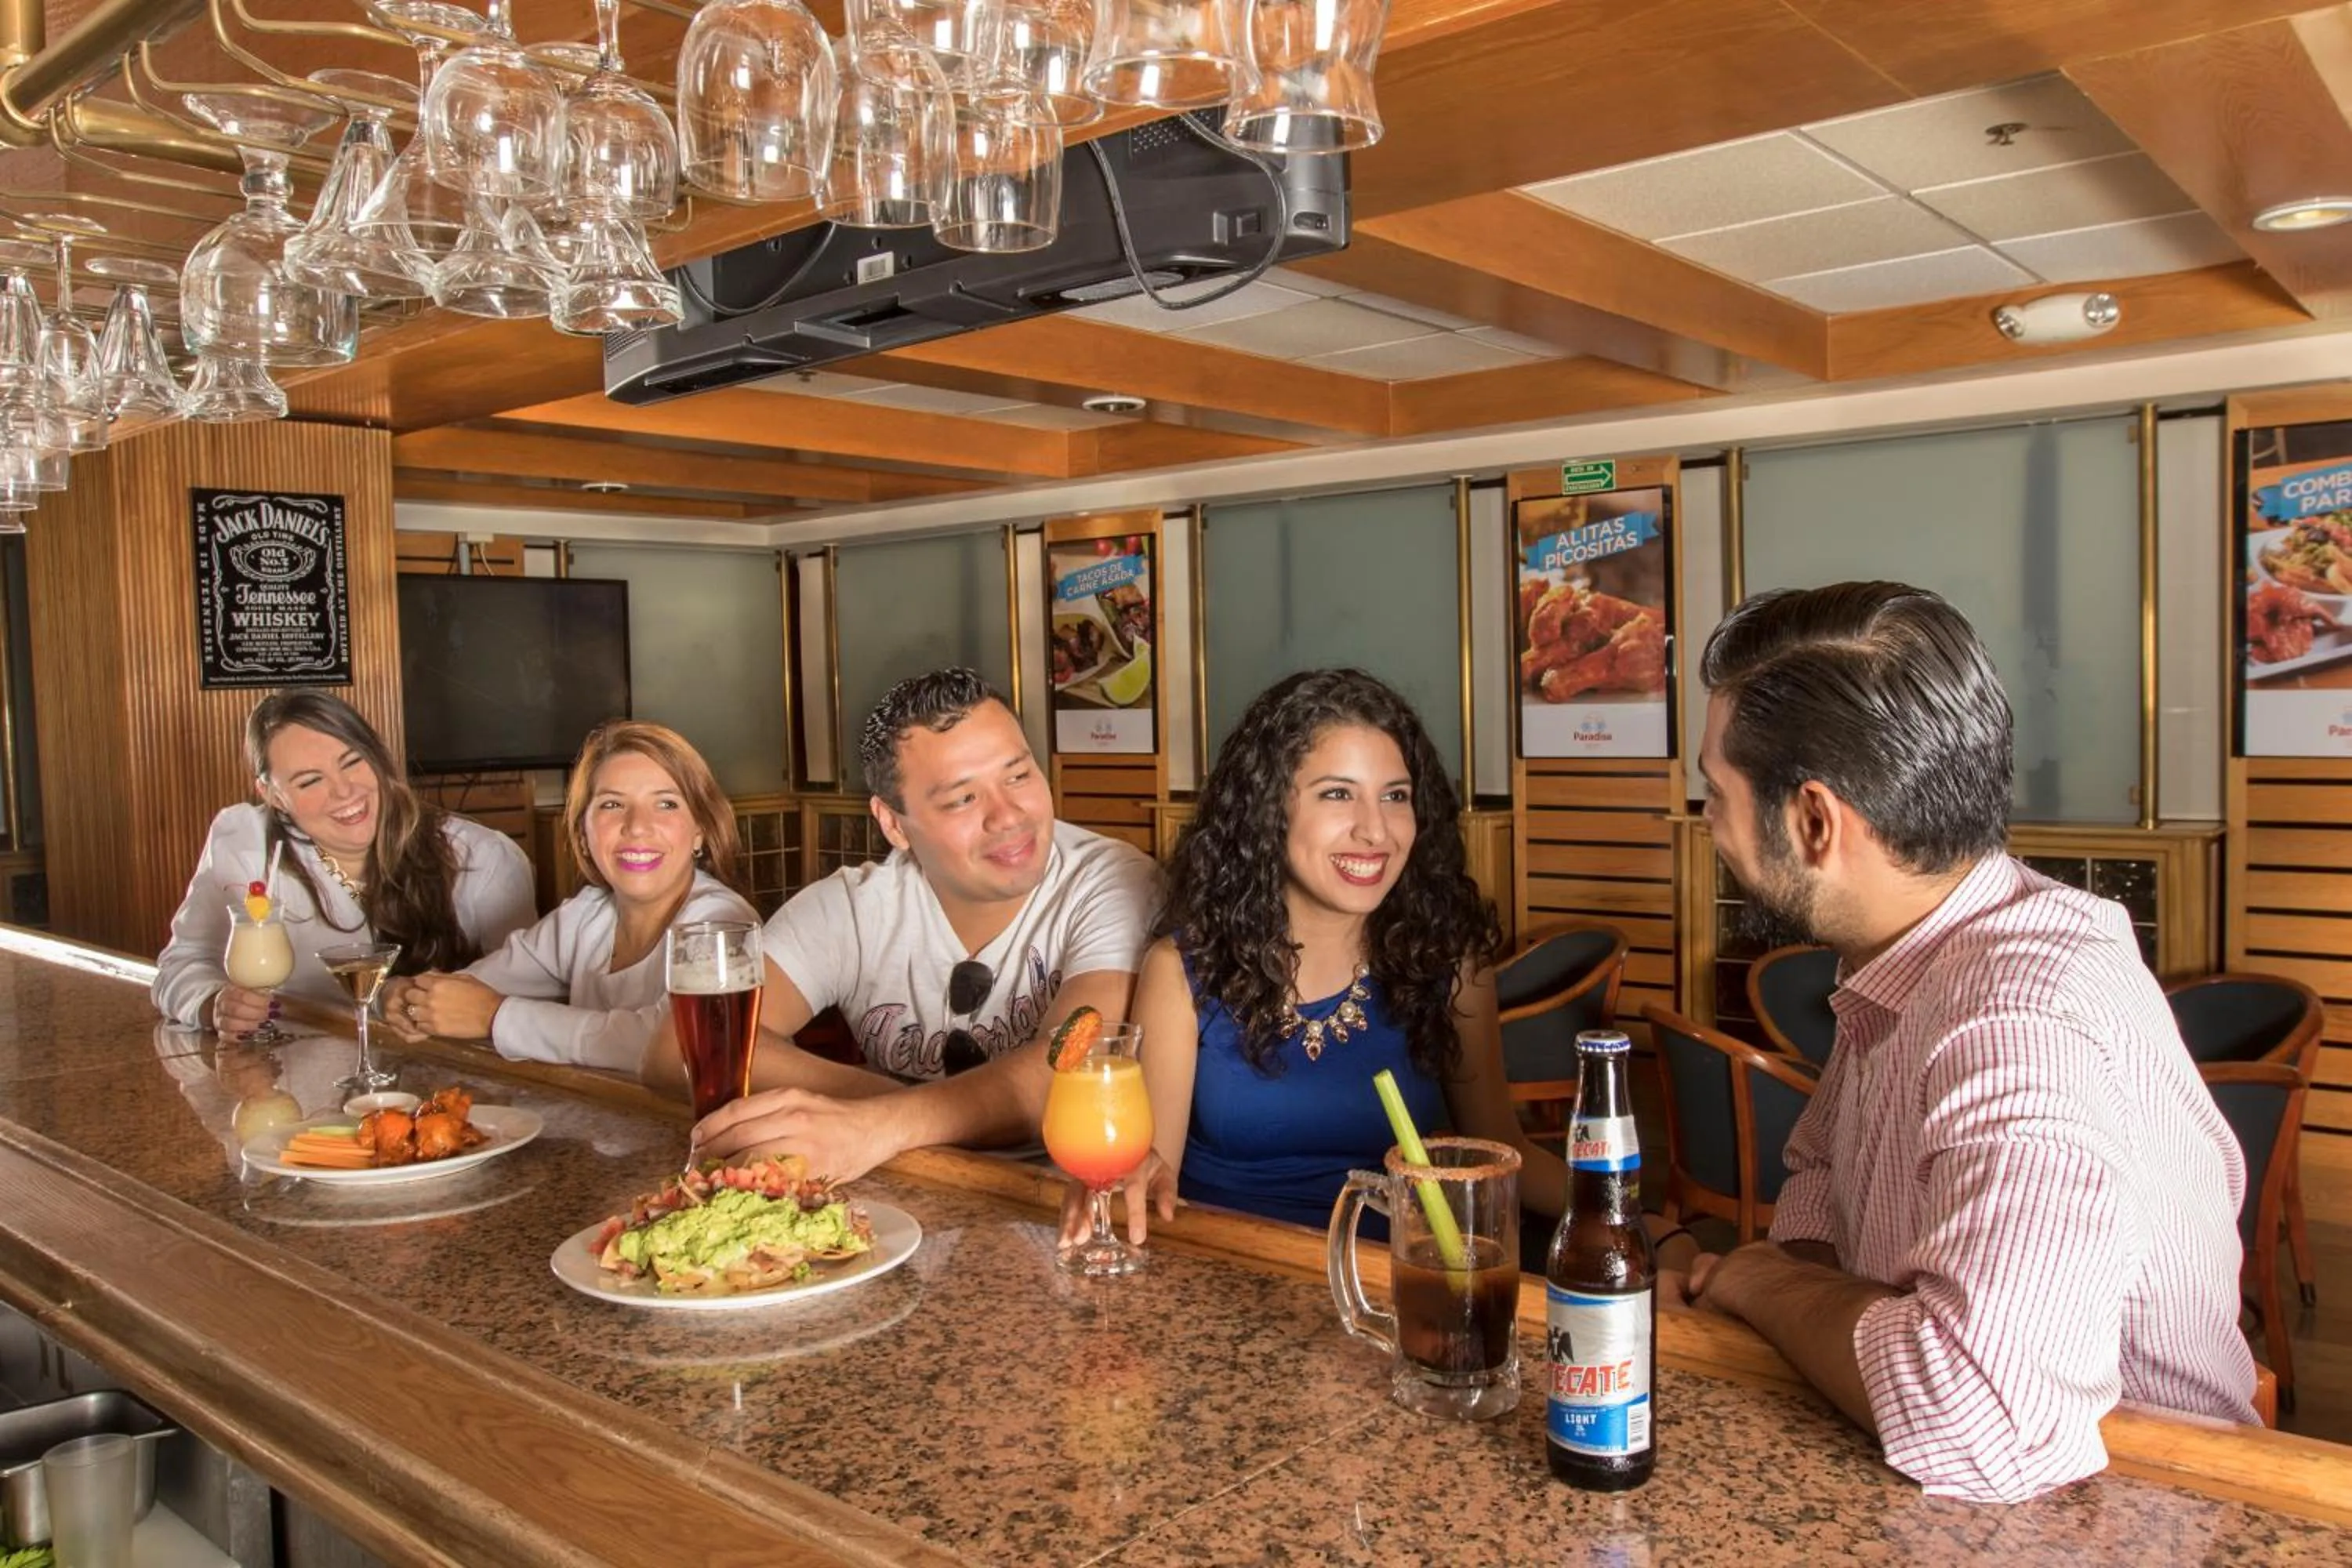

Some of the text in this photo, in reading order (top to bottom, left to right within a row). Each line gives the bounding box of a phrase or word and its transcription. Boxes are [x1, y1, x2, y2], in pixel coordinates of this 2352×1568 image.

[213, 502, 330, 546] JACK DANIEL'S
[1556, 517, 1625, 550] ALITAS
[1544, 531, 1638, 569] PICOSITAS
[198, 503, 214, 662] MADE IN TENNESSEE
[336, 573, 345, 593] THE
[1067, 568, 1134, 597] CARNE ASADA
[1076, 561, 1123, 583] TACOS DE
[236, 583, 317, 604] Tennessee
[338, 598, 347, 611] AT
[231, 612, 321, 626] WHISKEY
[339, 615, 349, 662] BOTTLED
[1565, 1414, 1598, 1425] LIGHT
